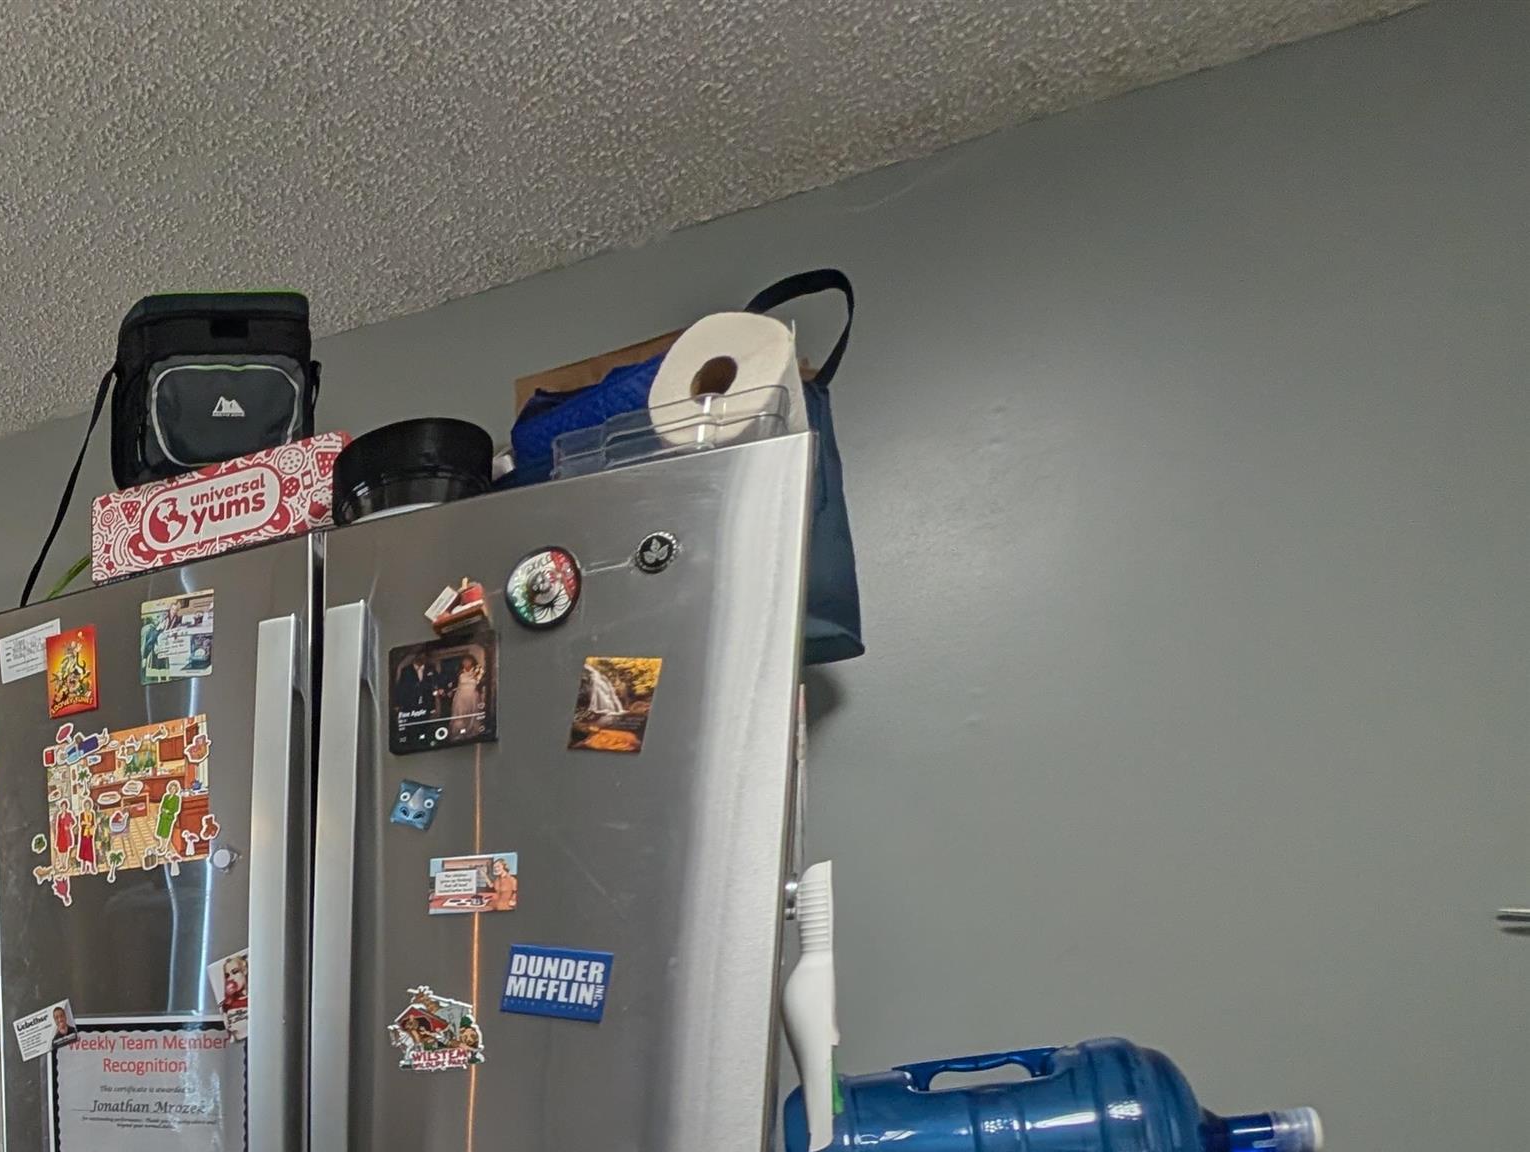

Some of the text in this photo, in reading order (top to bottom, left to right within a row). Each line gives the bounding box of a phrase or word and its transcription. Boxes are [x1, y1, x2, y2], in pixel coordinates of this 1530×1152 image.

[190, 473, 266, 506] universal
[190, 492, 266, 535] yums
[510, 954, 605, 984] DUNDER
[70, 1035, 116, 1053] Weekly
[119, 1035, 158, 1050] Team
[162, 1034, 230, 1050] Member
[103, 1057, 187, 1076] Recognition
[90, 1099, 149, 1113] Jonathan
